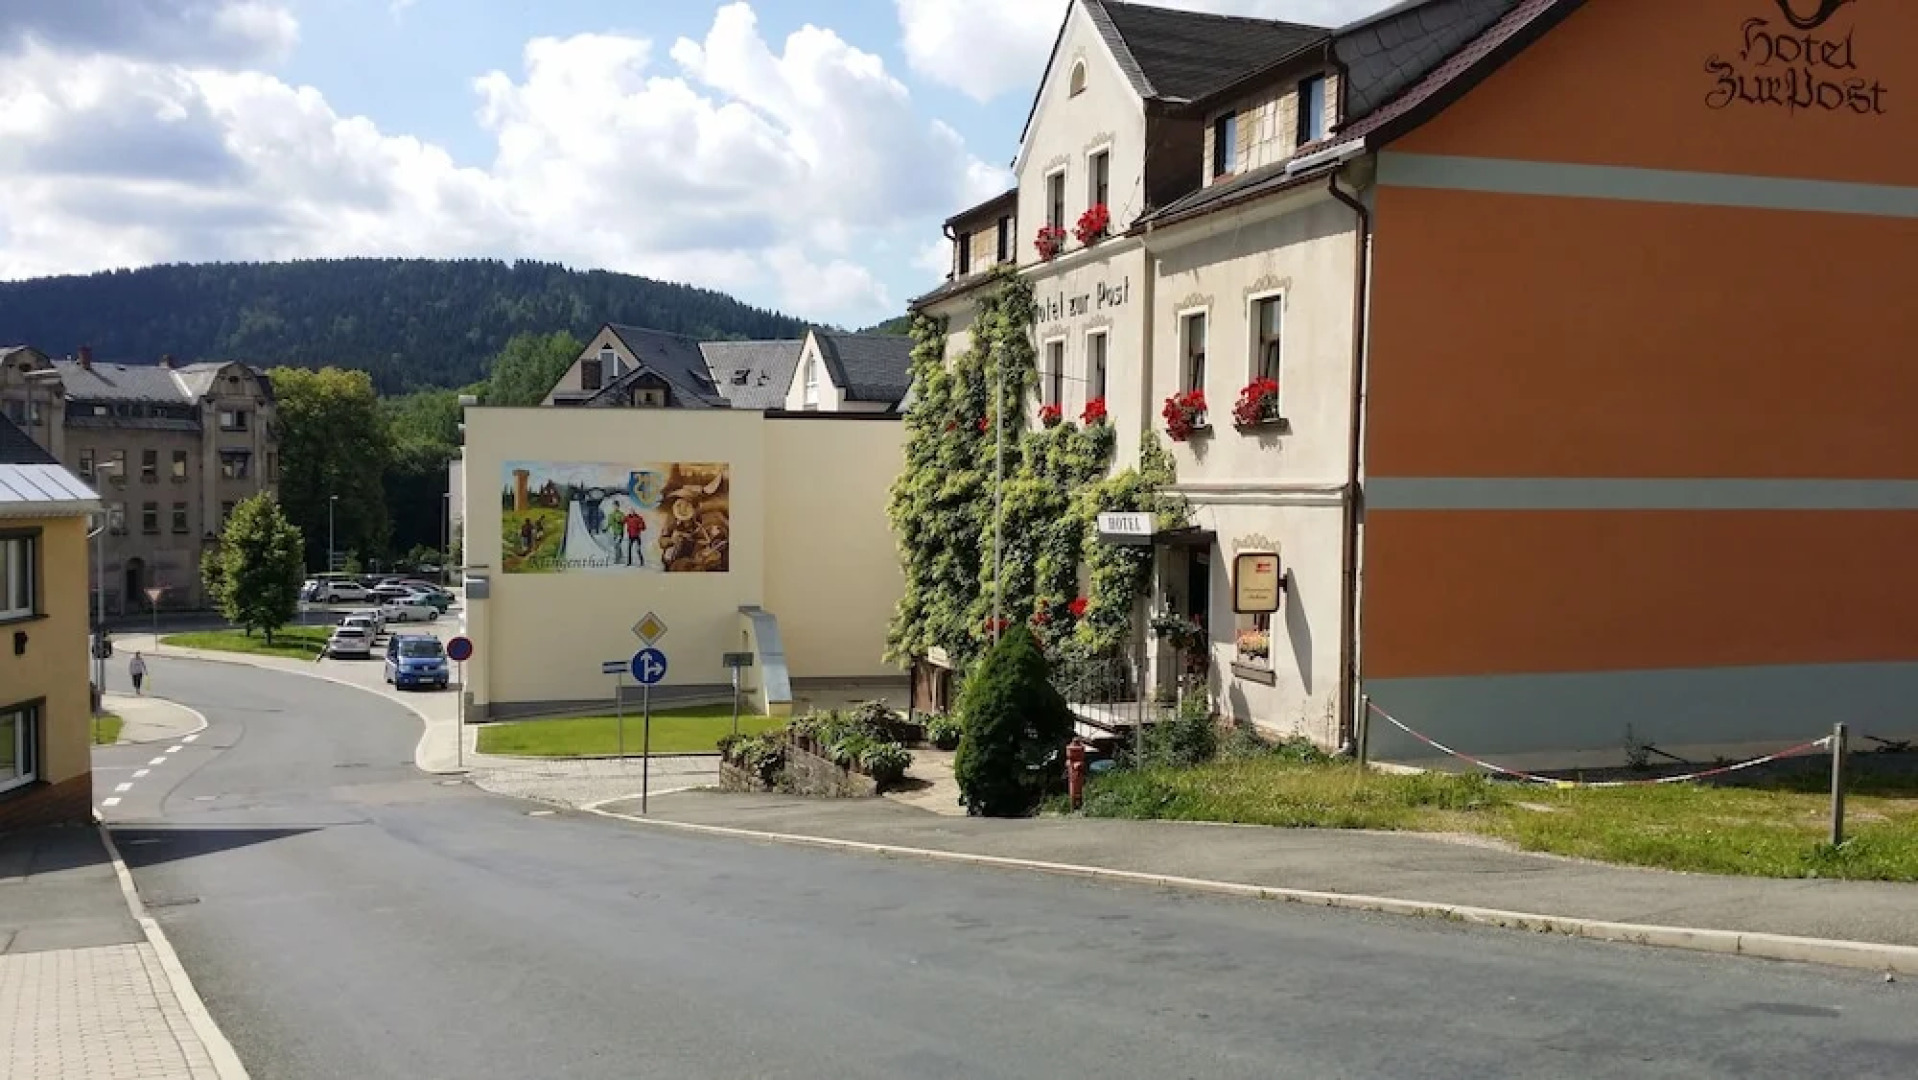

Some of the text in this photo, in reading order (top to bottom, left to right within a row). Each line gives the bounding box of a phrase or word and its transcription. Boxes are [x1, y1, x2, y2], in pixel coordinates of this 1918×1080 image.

[1740, 17, 1857, 70] Hotel
[1069, 293, 1090, 317] zur
[1096, 275, 1129, 309] Post
[1108, 516, 1141, 531] HOTEL
